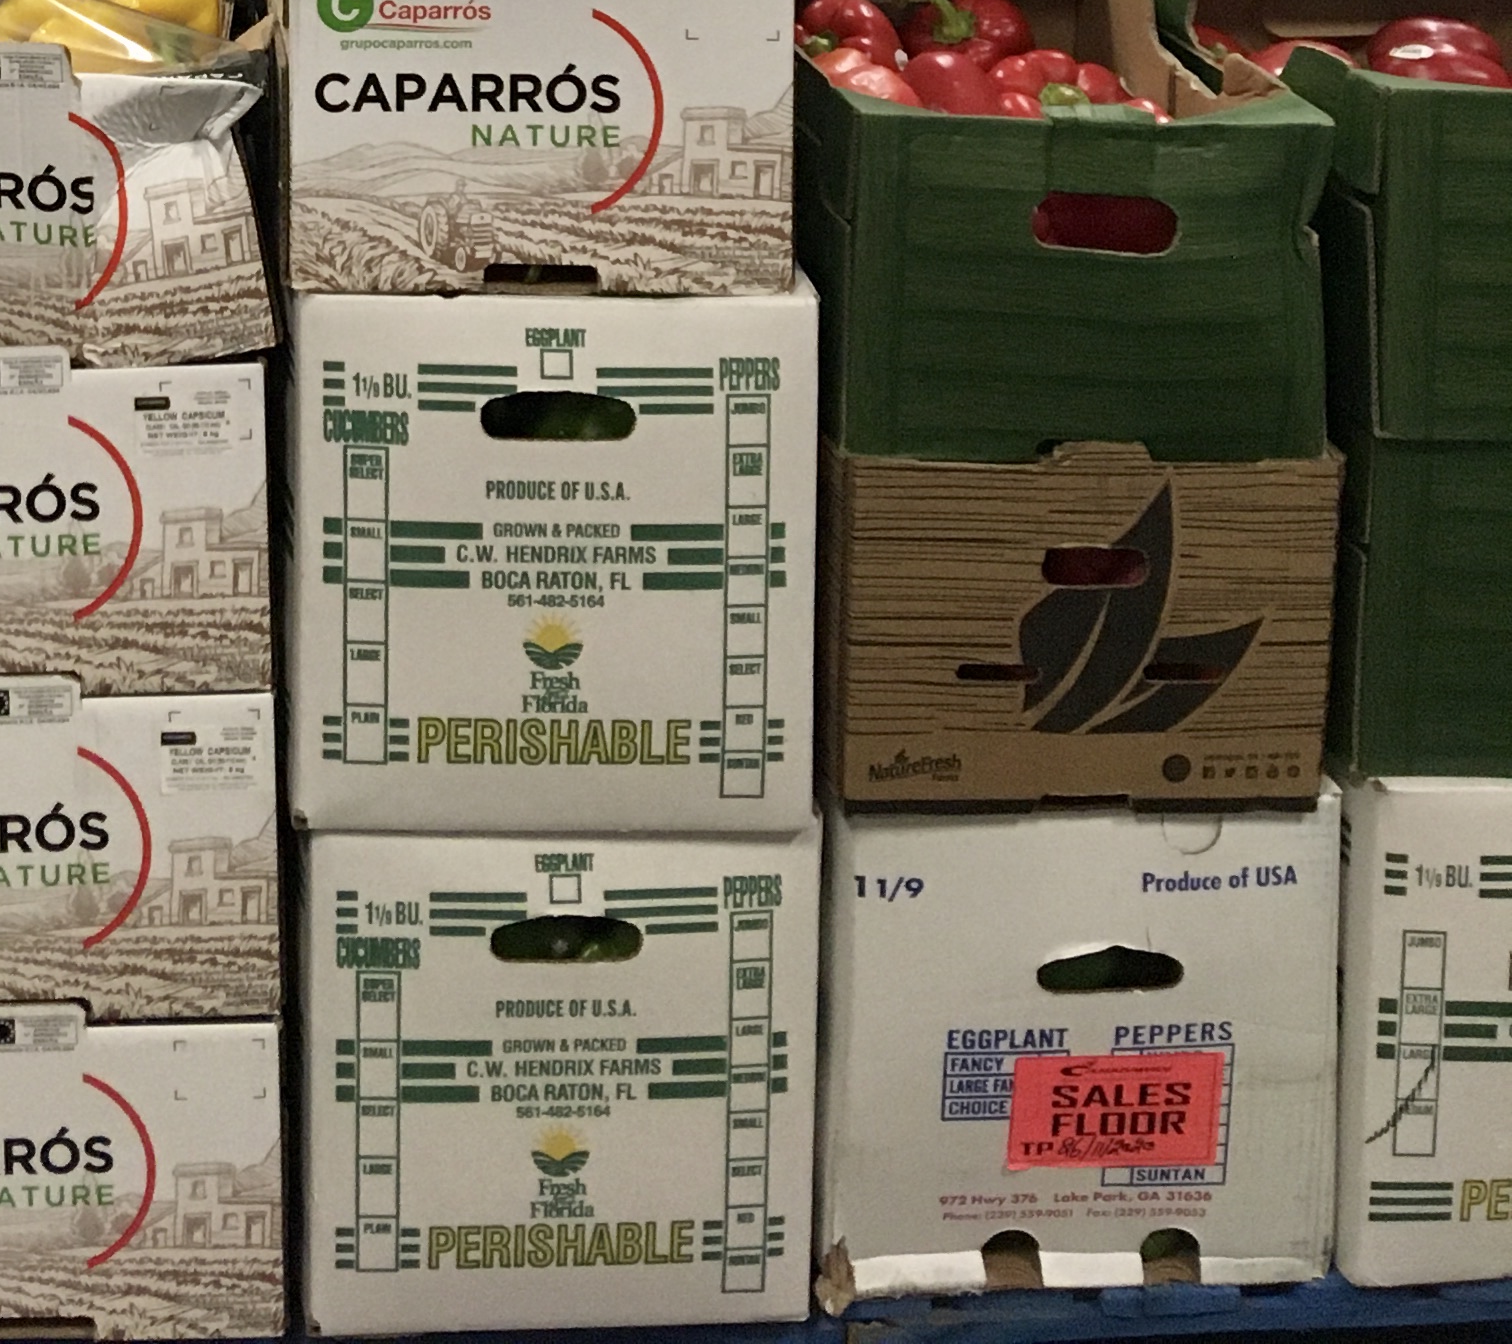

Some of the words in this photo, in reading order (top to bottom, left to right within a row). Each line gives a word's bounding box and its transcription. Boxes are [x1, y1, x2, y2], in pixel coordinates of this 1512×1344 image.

[379, 0, 491, 23] Caparrós
[340, 38, 472, 51] grupocaparros.com
[315, 64, 620, 113] CAPARRÓS
[473, 125, 620, 147] NATURE
[525, 327, 587, 348] EGGPLANT
[719, 356, 781, 391] PEPPERS
[383, 373, 412, 399] BU.
[323, 409, 410, 446] CUCUMBERS
[485, 480, 556, 500] PRODUCE
[560, 480, 580, 500] OF
[584, 481, 631, 501] U.S.A.
[493, 522, 548, 538] GROWN
[551, 523, 562, 538] &
[566, 523, 621, 539] PACKED
[456, 544, 498, 563] C.W.
[506, 545, 588, 564] HENDRIX
[593, 546, 657, 565] FARMS
[482, 570, 532, 590] BOCA
[536, 571, 603, 593] RATON,
[610, 572, 632, 591] FL
[507, 594, 605, 608] 561-482-5164
[529, 670, 581, 690] Fresh
[417, 717, 692, 765] PERISHABLE
[534, 852, 595, 873] EGGPLANT
[1141, 871, 1222, 894] Produce
[1228, 868, 1249, 889] of
[1256, 865, 1299, 888] USA
[1445, 864, 1473, 889] BU.
[723, 873, 783, 909] PEPPERS
[395, 901, 424, 926] BU.
[336, 936, 421, 969] CUCUMBERS
[495, 999, 565, 1019] PRODUCE
[569, 999, 589, 1018] OF
[592, 998, 637, 1018] U.S.A.
[1405, 993, 1438, 1004] EXTRA
[946, 1027, 1070, 1050] EGGPLANT
[1114, 1021, 1233, 1046] PEPPERS
[502, 1038, 557, 1054] GROWN
[573, 1037, 627, 1053] PACKED
[466, 1059, 508, 1078] C.W.
[514, 1059, 595, 1078] HENDRIX
[600, 1057, 662, 1076] FARMS
[949, 1056, 1005, 1073] FANCY
[490, 1083, 540, 1102] BOCA
[544, 1083, 610, 1105] RATON,
[616, 1083, 637, 1101] FL
[949, 1078, 989, 1094] LARGE
[1051, 1082, 1193, 1109] SALES
[948, 1100, 1008, 1116] CHOICE
[1050, 1110, 1187, 1137] FLOOR
[1136, 1167, 1206, 1181] SUNTAN
[538, 1178, 587, 1197] Fresh
[939, 1194, 968, 1206] 972
[972, 1194, 1006, 1207] Hwy
[1053, 1192, 1089, 1204] Lake
[1137, 1191, 1161, 1202] GA
[1165, 1190, 1213, 1202] 31636
[427, 1219, 695, 1270] PERISHABLE
